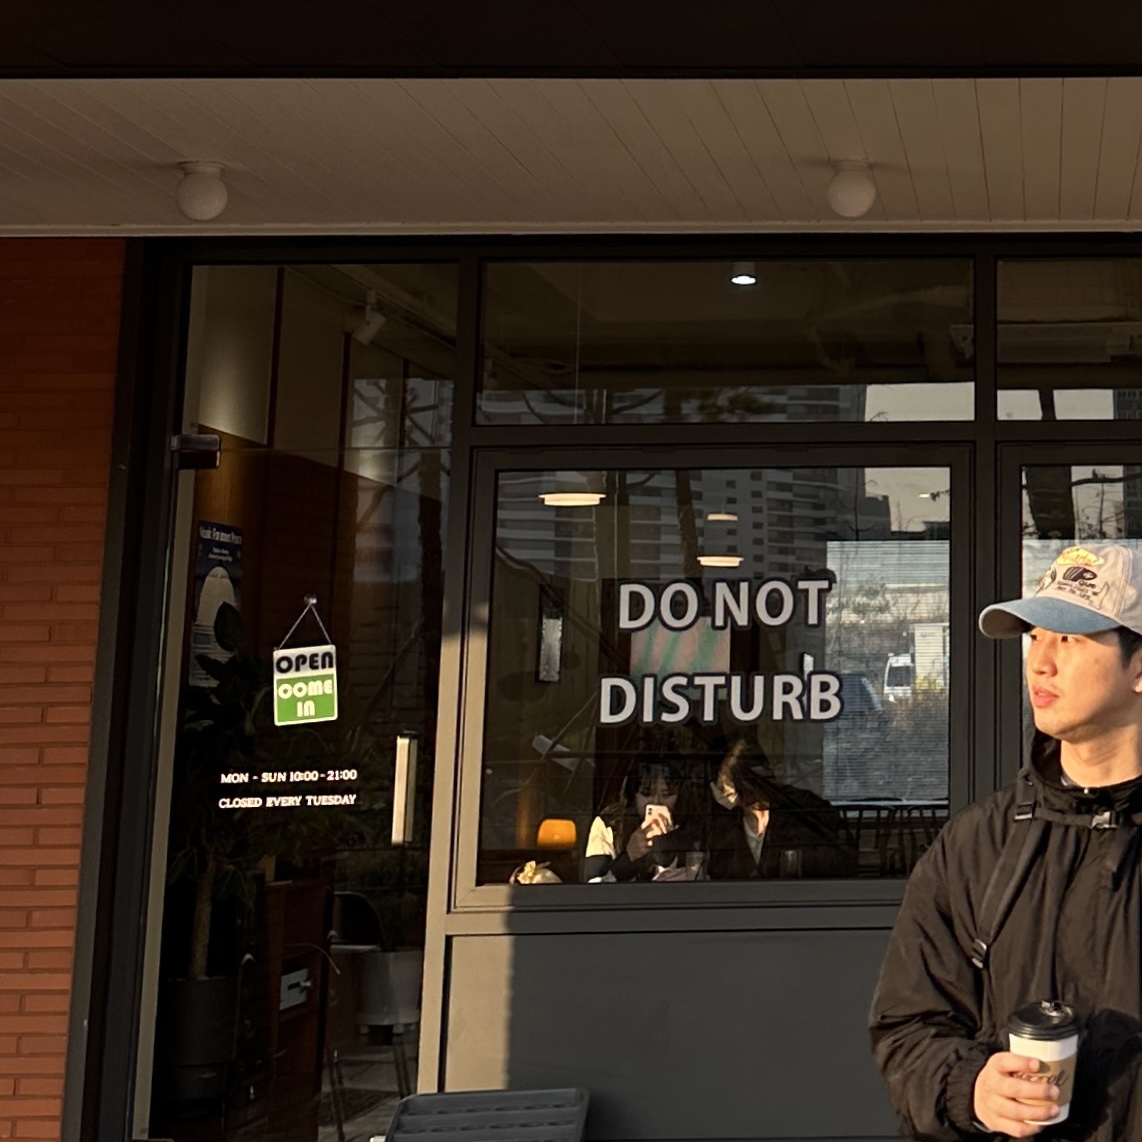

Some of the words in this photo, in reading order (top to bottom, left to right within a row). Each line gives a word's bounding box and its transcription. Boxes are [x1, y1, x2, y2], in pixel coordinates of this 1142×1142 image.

[619, 582, 699, 630] DO
[714, 579, 830, 627] NOT
[275, 651, 334, 674] OPEN
[278, 680, 333, 700] COME
[600, 673, 842, 724] DISTURB
[296, 700, 316, 718] IN
[220, 773, 250, 784] MON
[261, 772, 287, 783] SUN
[218, 797, 263, 809] CLOSED
[265, 796, 303, 807] EVERY
[305, 794, 357, 806] TUESDAY
